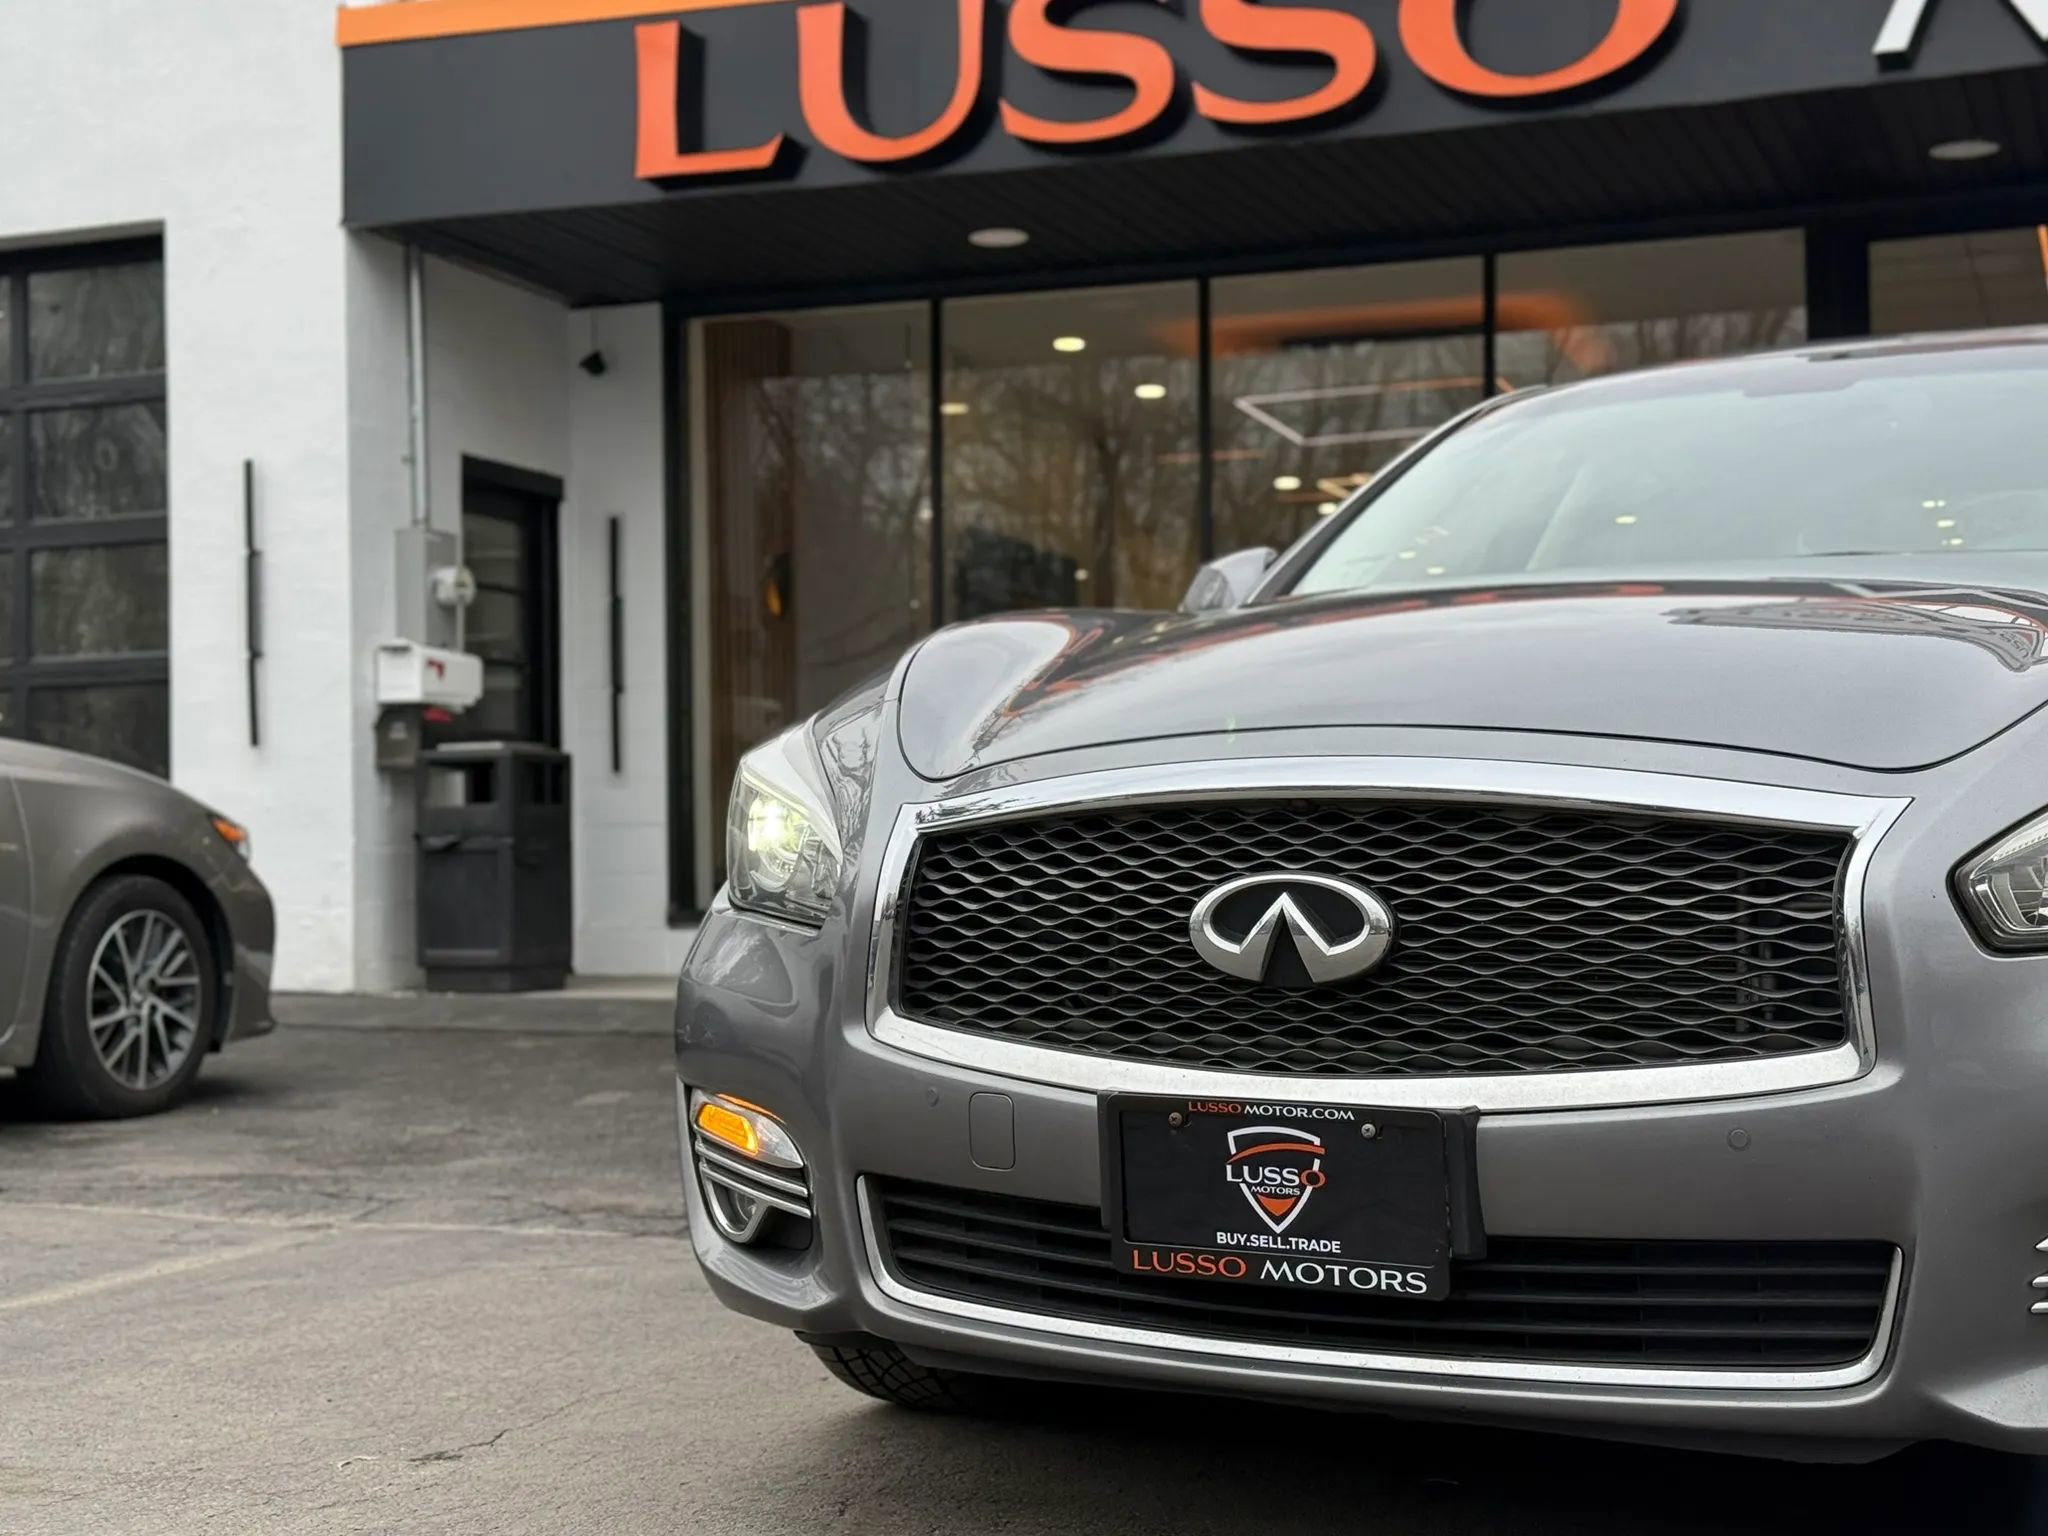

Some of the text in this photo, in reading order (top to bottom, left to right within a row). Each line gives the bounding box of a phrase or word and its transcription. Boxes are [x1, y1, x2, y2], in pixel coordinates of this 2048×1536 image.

[1188, 1101, 1355, 1121] LUSSO MOTOR.COM
[1226, 1164, 1326, 1188] LUSSO
[1250, 1185, 1301, 1196] MOTORS
[1216, 1231, 1342, 1253] BUY.SELL.TRADE
[1132, 1249, 1428, 1295] LUSSO MOTORS
